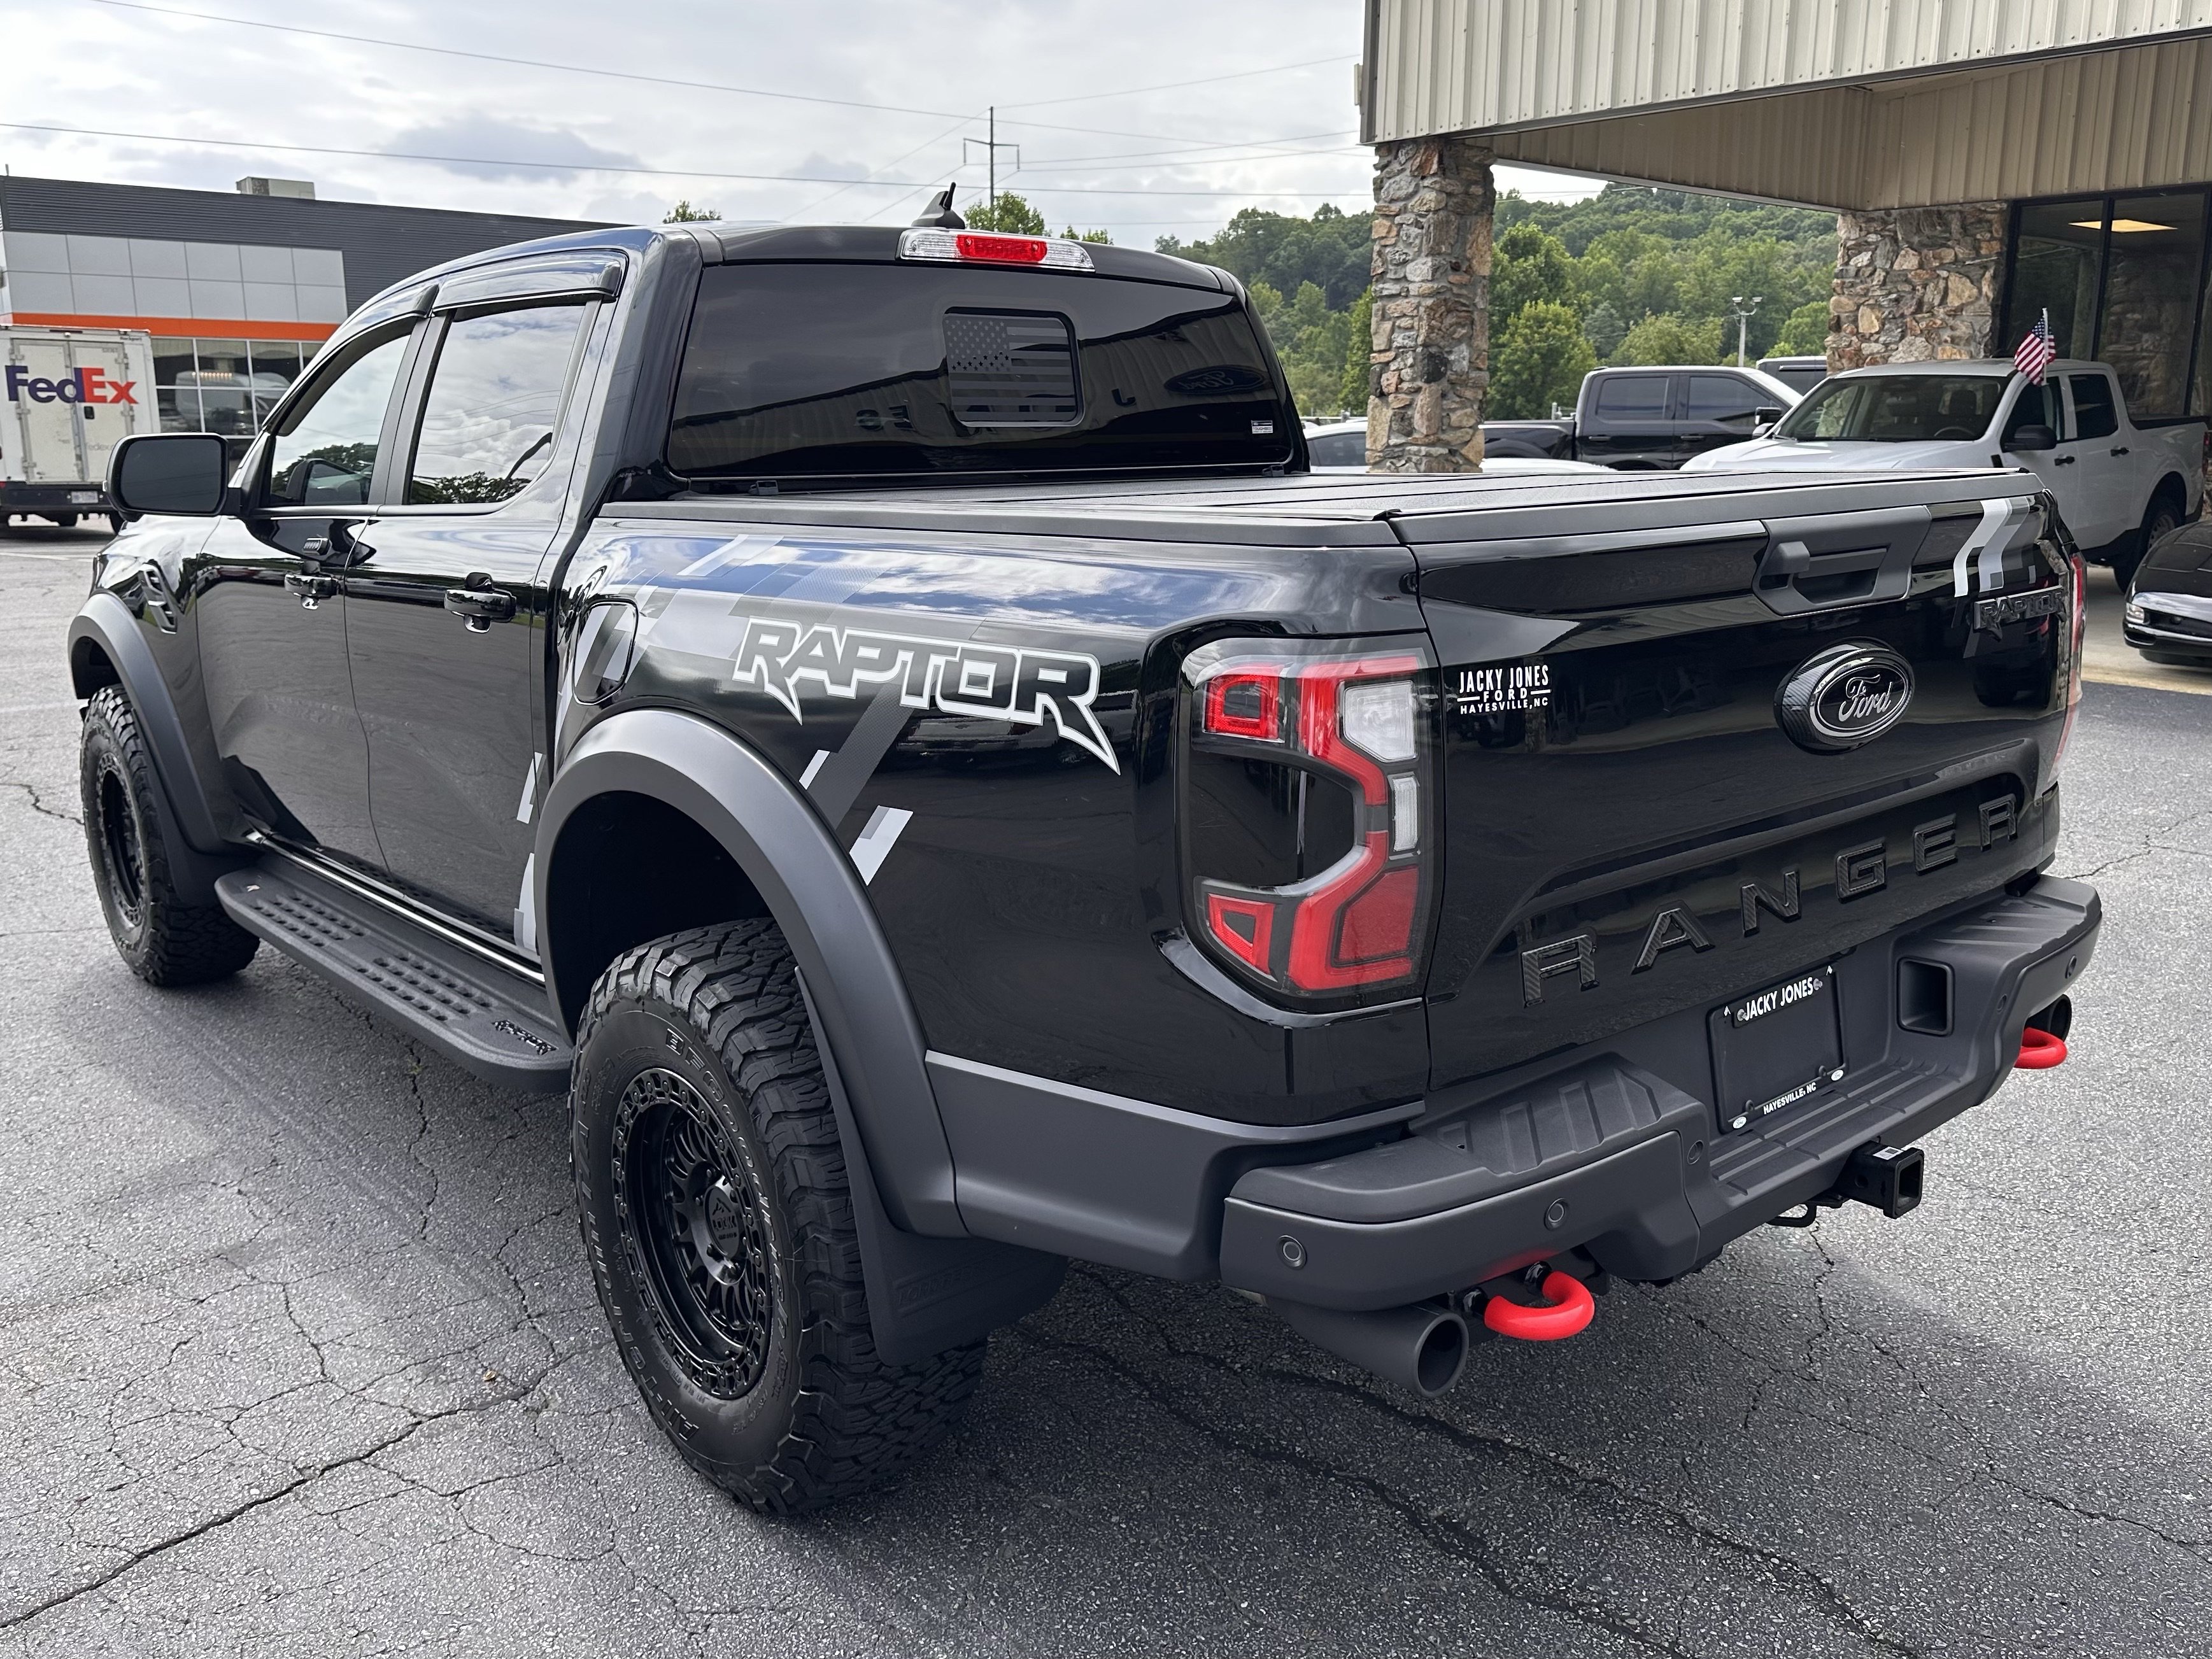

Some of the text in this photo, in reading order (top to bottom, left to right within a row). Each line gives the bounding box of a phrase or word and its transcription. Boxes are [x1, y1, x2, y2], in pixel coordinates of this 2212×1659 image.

[5, 365, 139, 404] FedEx
[1974, 586, 2068, 642] RAPTOR
[732, 616, 1121, 776] RAPTOR
[1459, 665, 1549, 693] JACKY JONES
[1484, 688, 1528, 703] FORD
[1838, 674, 1893, 722] Ford
[1521, 793, 2021, 1008] RANGER
[1745, 977, 1813, 1021] JACKY JONES
[1806, 1082, 1817, 1094] NC
